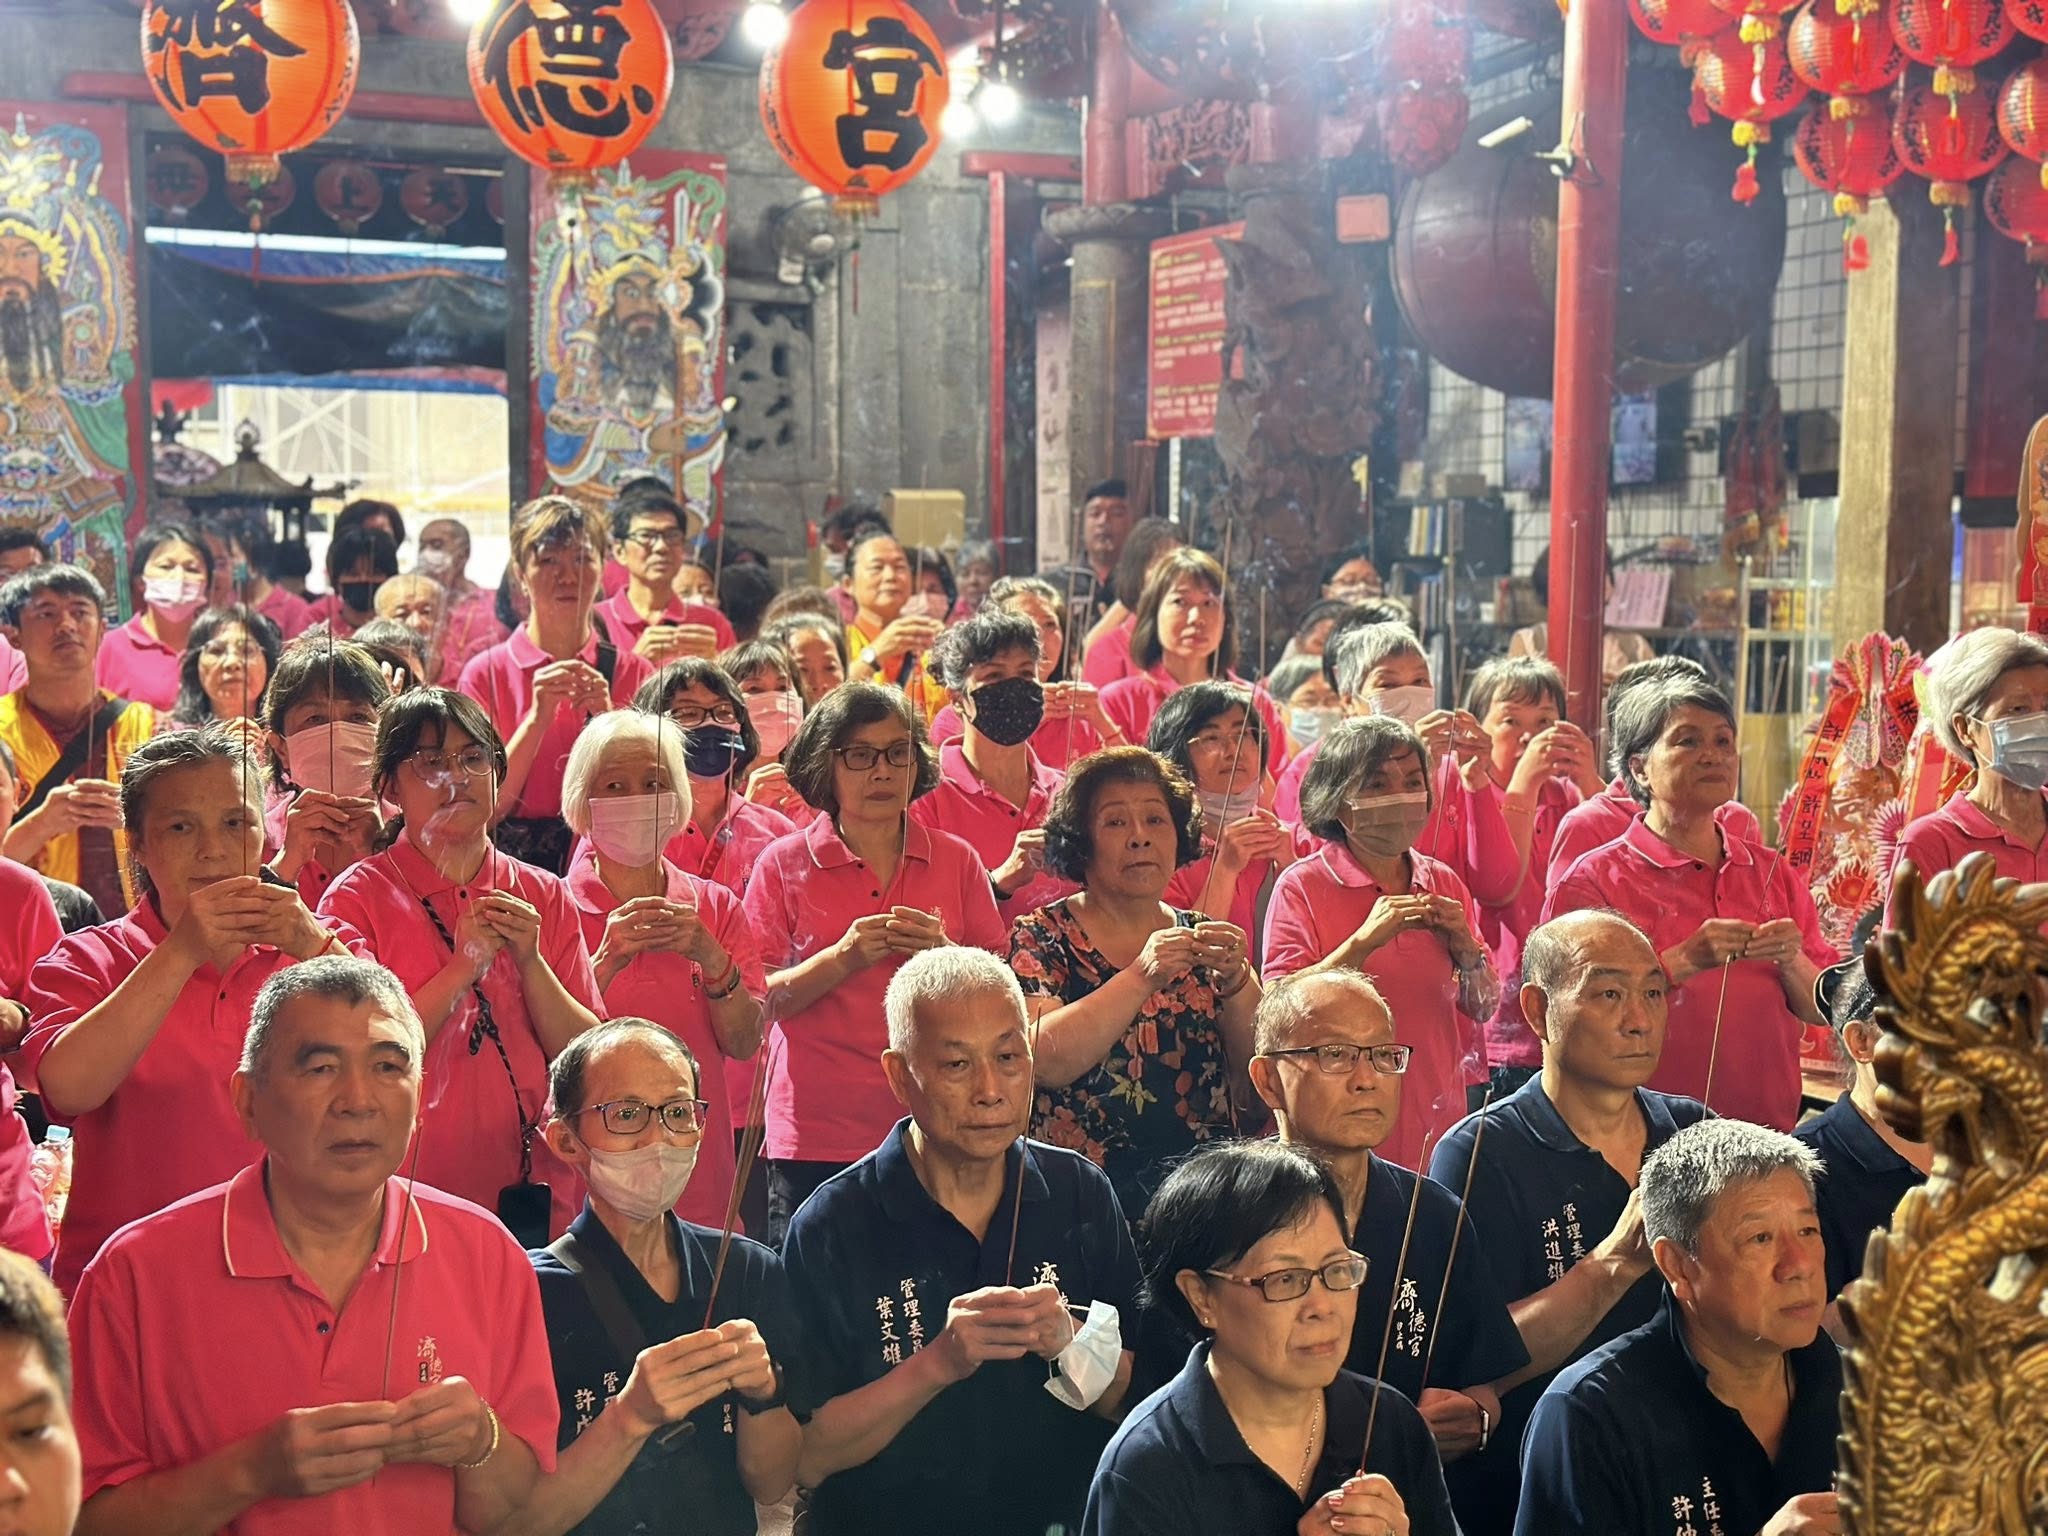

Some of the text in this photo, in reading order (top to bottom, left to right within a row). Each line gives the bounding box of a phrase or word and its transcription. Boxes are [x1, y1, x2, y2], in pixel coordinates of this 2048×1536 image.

[480, 0, 655, 137] 德
[822, 16, 943, 172] 宮
[875, 1296, 902, 1366] 葉文雄
[900, 1277, 924, 1354] 管理委員
